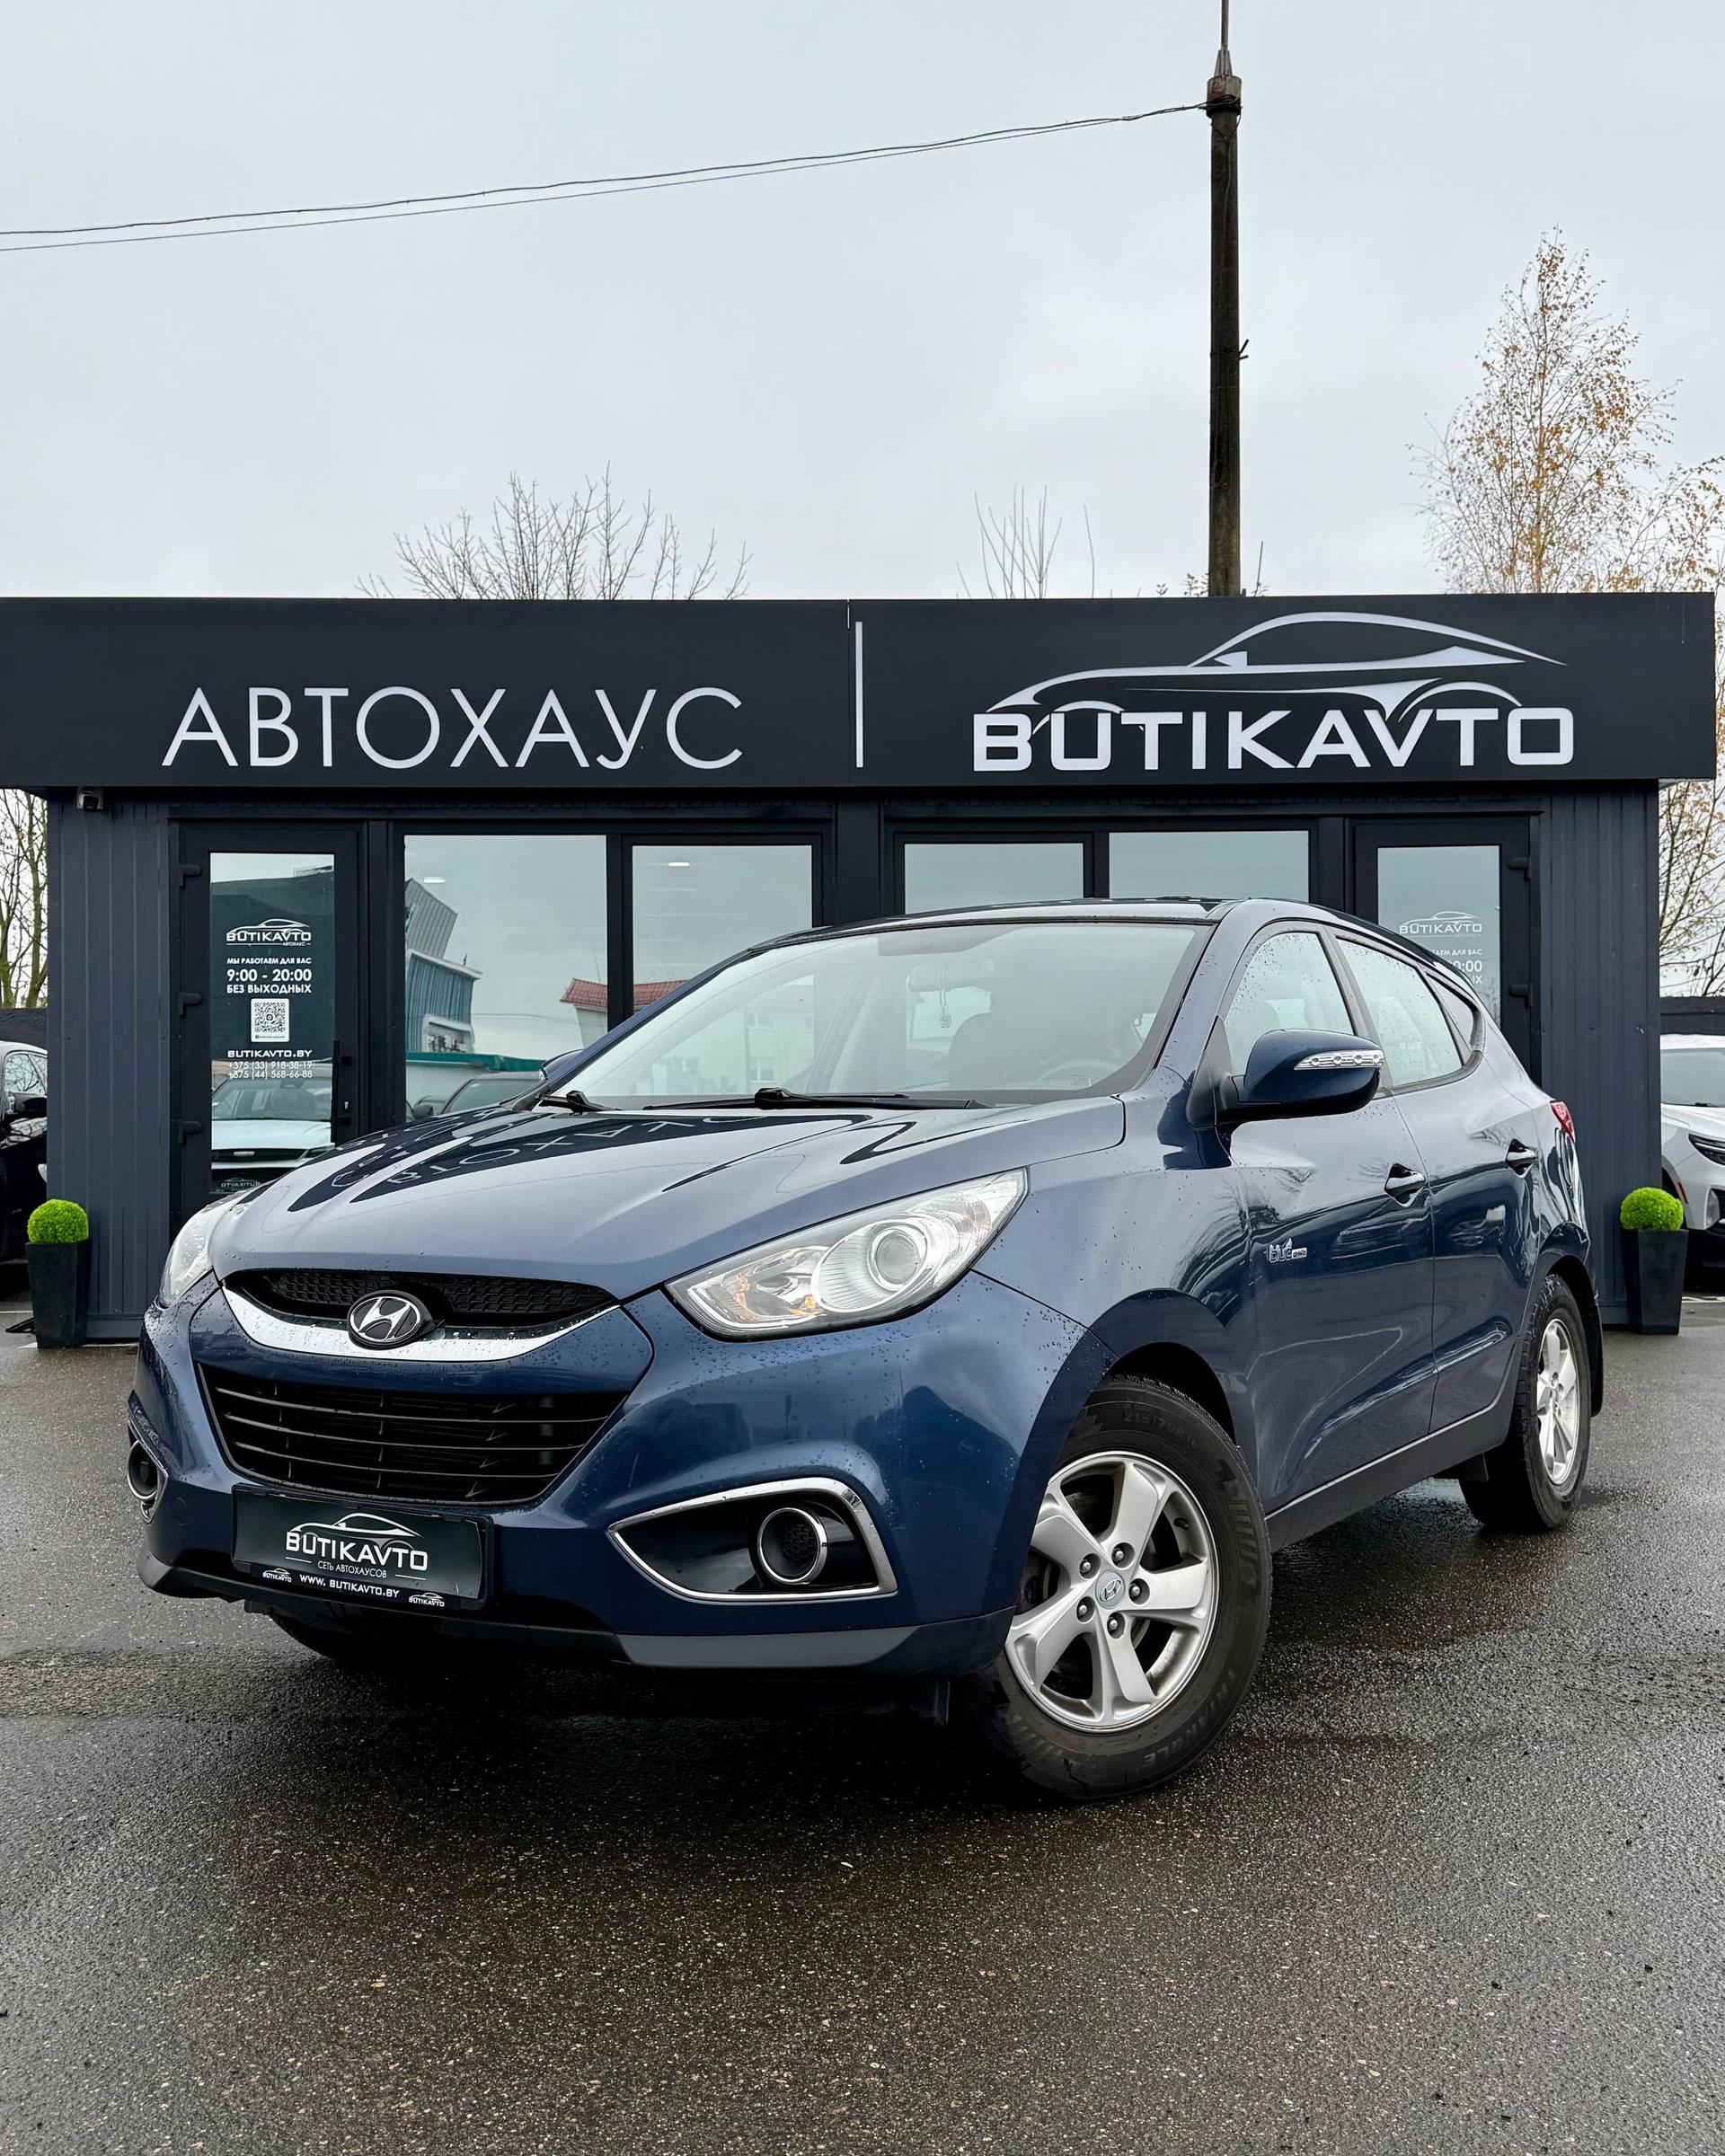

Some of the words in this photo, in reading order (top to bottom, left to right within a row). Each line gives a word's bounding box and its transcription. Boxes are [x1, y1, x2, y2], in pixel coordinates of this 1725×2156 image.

[162, 686, 743, 770] АВТОХАУС
[973, 706, 1574, 773] BUTIKAVTO
[1399, 923, 1482, 934] BUTIKAVTO
[226, 931, 312, 941] BUTIKAVTO
[226, 957, 240, 965] МЫ
[241, 957, 279, 965] РАБОТАЕМ
[279, 957, 295, 966] ДЛЯ
[296, 957, 312, 965] ВАС
[226, 968, 258, 982] 9:00
[271, 968, 312, 982] 20:00
[226, 984, 245, 994] БЕЗ
[247, 984, 312, 994] ВЫХОДНЫХ
[227, 1049, 313, 1058] BUTIKAVTO.BY
[228, 1061, 250, 1070] +375
[251, 1060, 268, 1071] (33)
[270, 1060, 313, 1070] 918-38-19
[251, 1070, 268, 1080] (44)
[270, 1070, 313, 1079] 568-66-88
[286, 1532, 429, 1571] BUTIKAVTO
[317, 1560, 334, 1571] СЕТЬ
[335, 1564, 387, 1578] АВТОХАУСОВ
[262, 1571, 292, 1583] BUTIKAVTO
[299, 1573, 326, 1586] WWW.
[329, 1579, 401, 1598] BUTIKAVTO.BY
[409, 1596, 445, 1607] BUTIKAVTO
